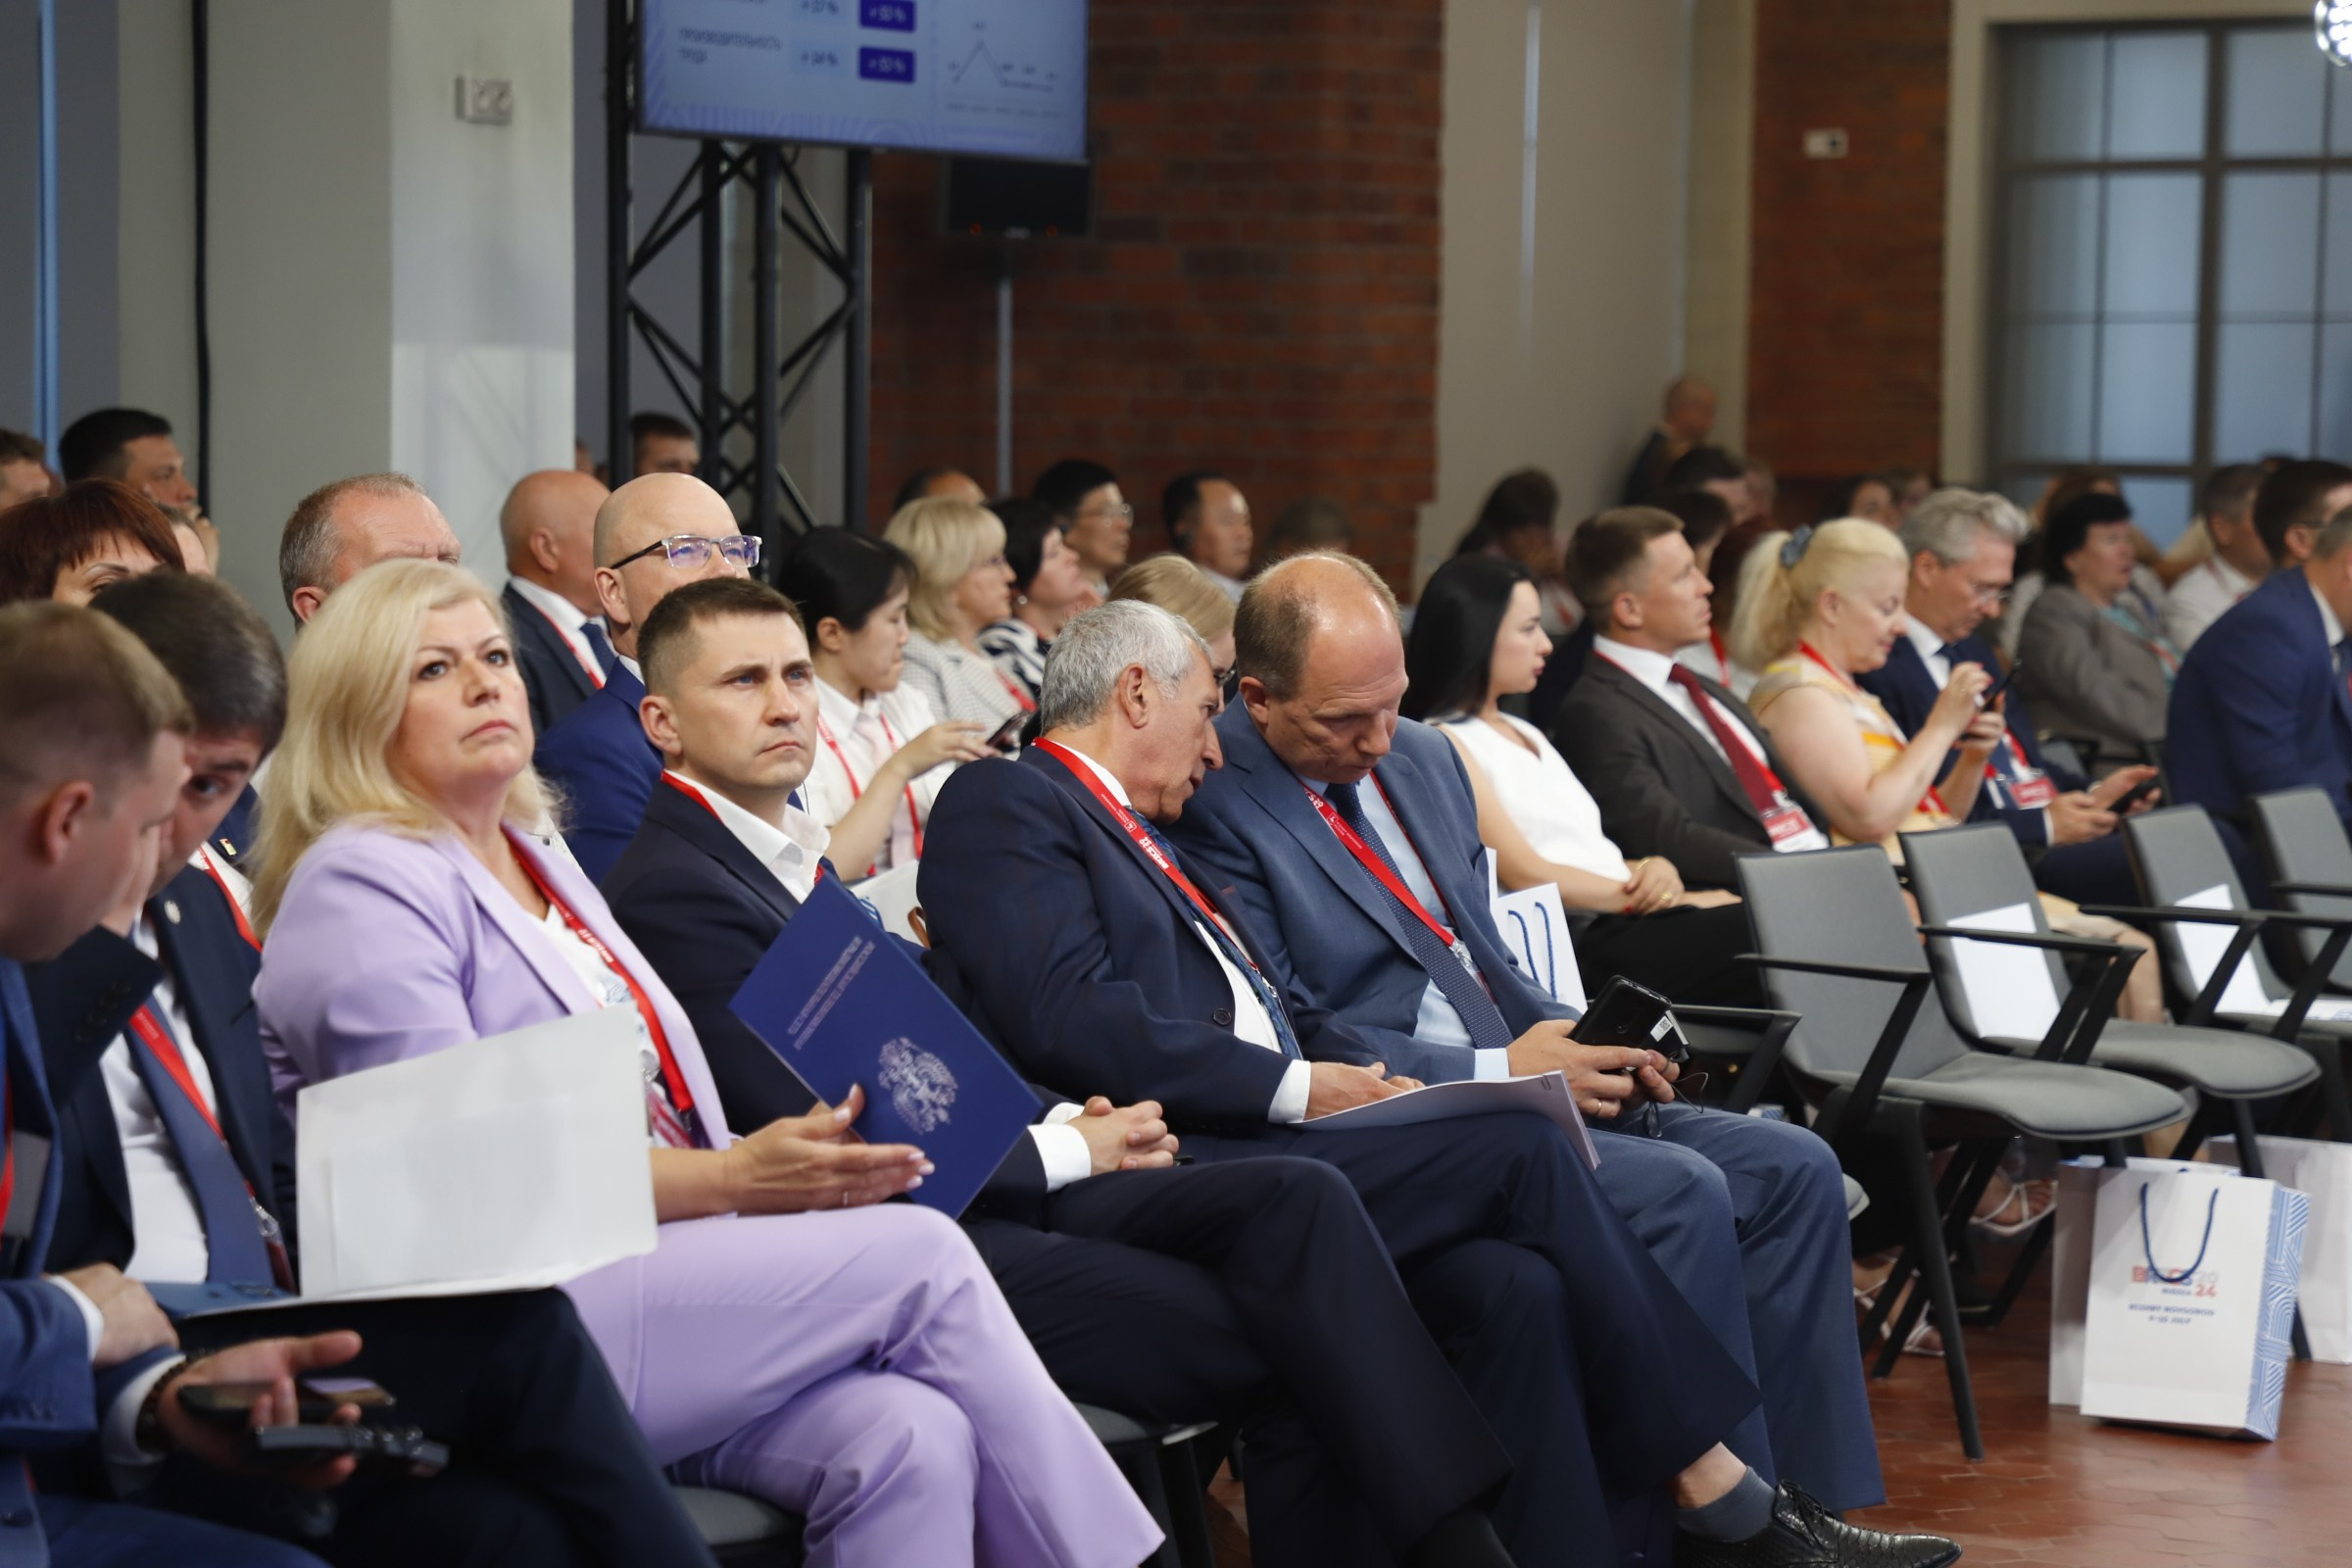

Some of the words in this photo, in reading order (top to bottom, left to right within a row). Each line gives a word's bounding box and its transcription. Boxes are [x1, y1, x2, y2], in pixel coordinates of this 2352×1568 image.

[1138, 838, 1149, 849] 20
[1147, 845, 1170, 870] BRICS
[2195, 1284, 2217, 1298] 24
